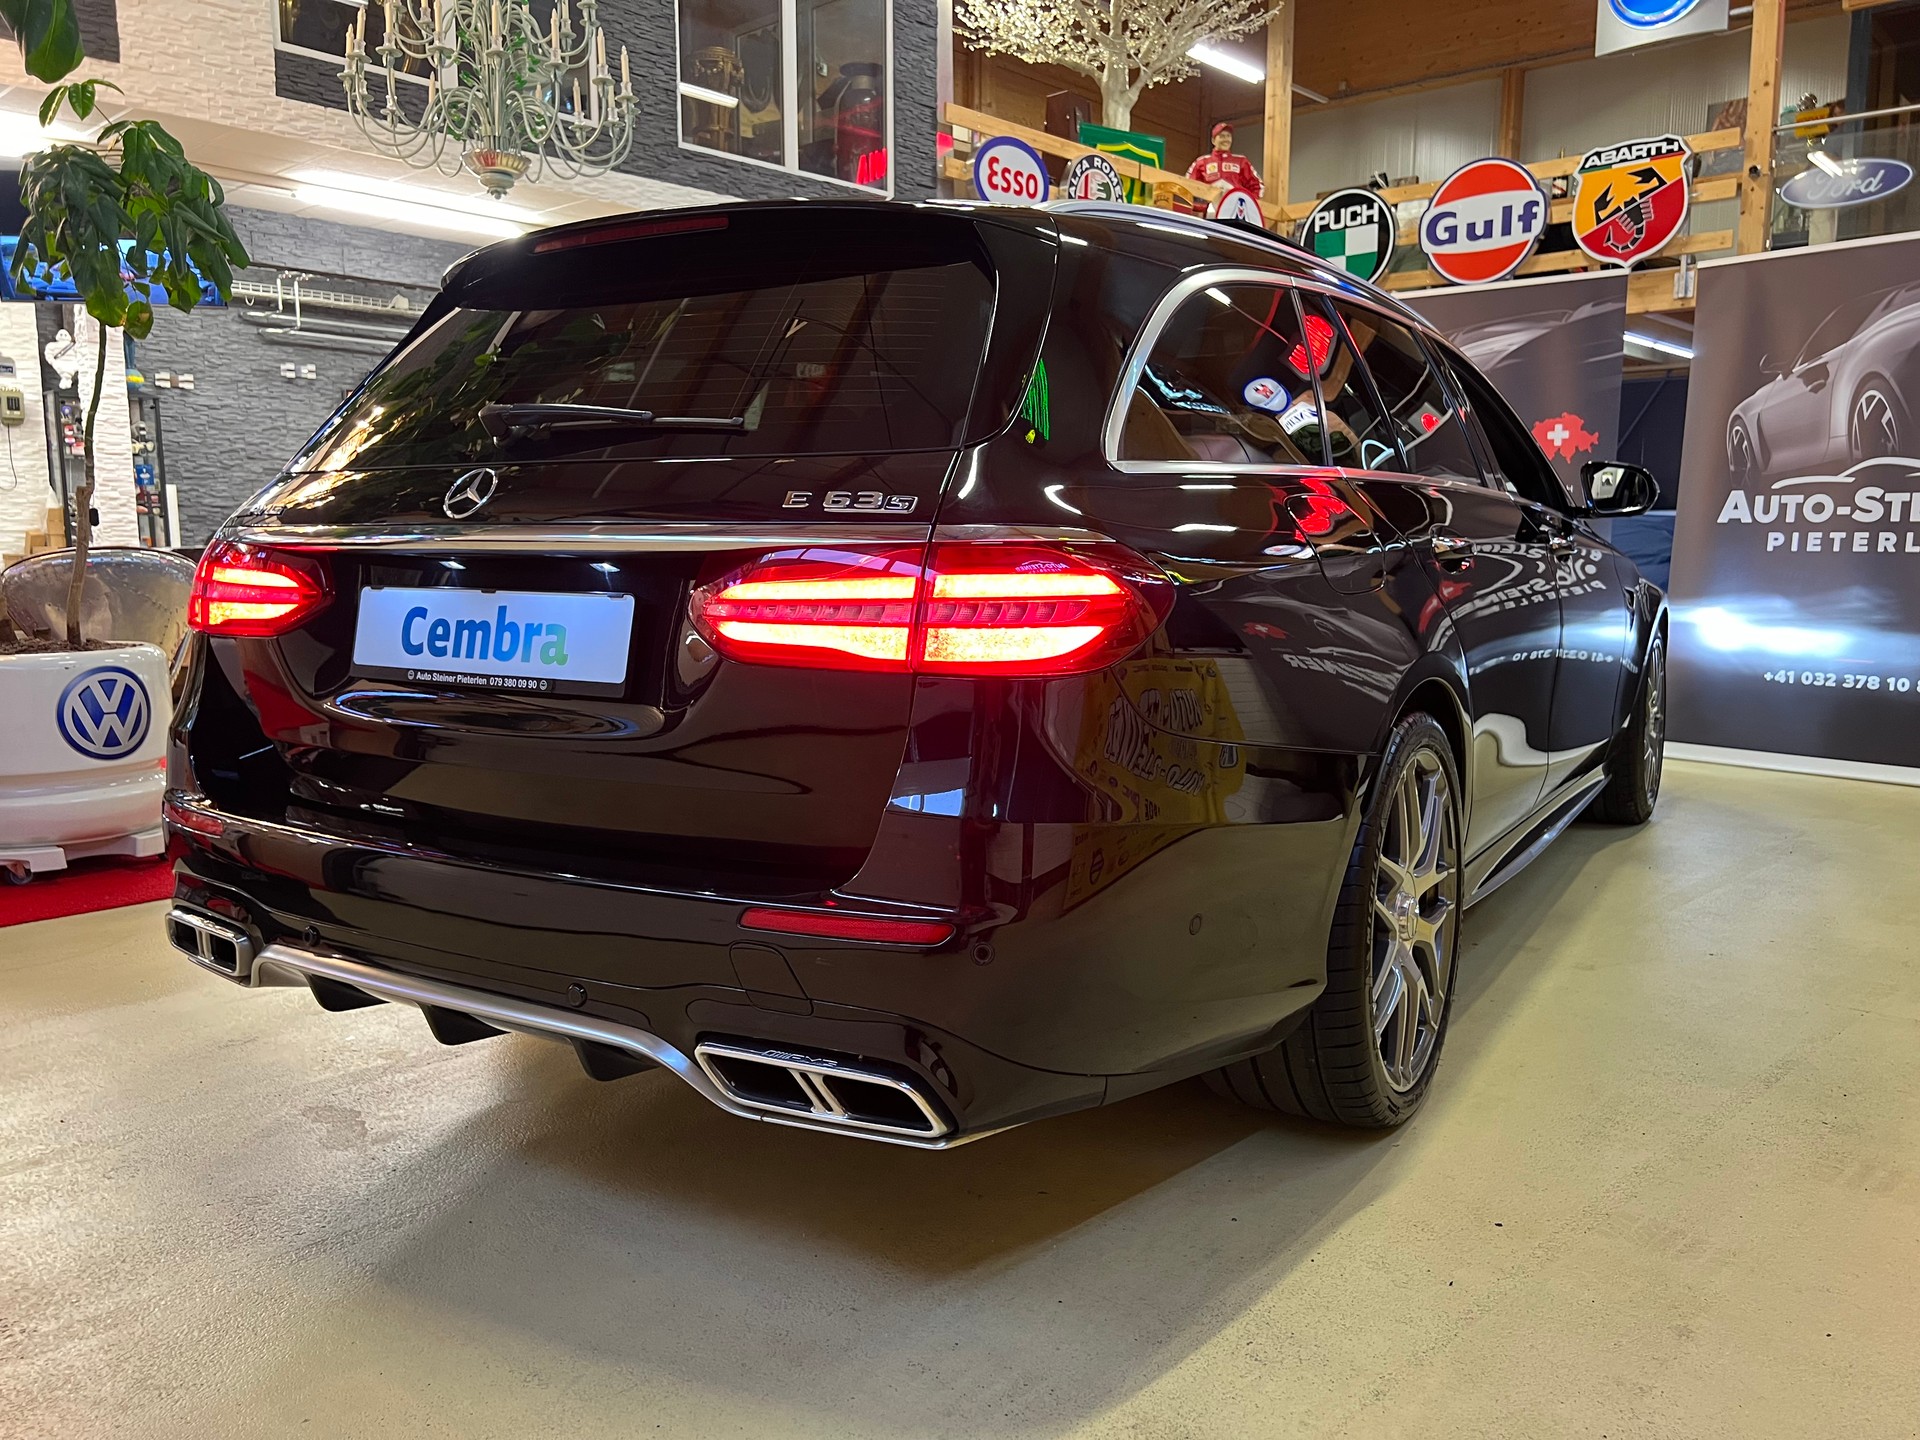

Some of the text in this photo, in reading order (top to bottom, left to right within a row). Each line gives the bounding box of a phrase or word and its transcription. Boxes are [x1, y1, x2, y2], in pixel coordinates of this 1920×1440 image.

[1584, 141, 1680, 169] ABARTH
[1069, 159, 1090, 199] ALFA
[1806, 166, 1885, 200] Ford
[1313, 201, 1380, 234] PUCH
[1425, 200, 1540, 247] Gulf
[782, 490, 813, 508] E
[1766, 531, 1920, 553] PIETERL
[401, 605, 569, 667] Cembra
[416, 671, 431, 680] Auto
[432, 672, 456, 683] Steiner
[489, 678, 503, 686] 079
[503, 678, 517, 688] 380
[517, 679, 527, 688] 09
[528, 680, 538, 689] 90
[1763, 670, 1795, 684] +41
[1801, 671, 1837, 687] 032
[1842, 674, 1881, 690] 378
[1886, 677, 1910, 692] 10
